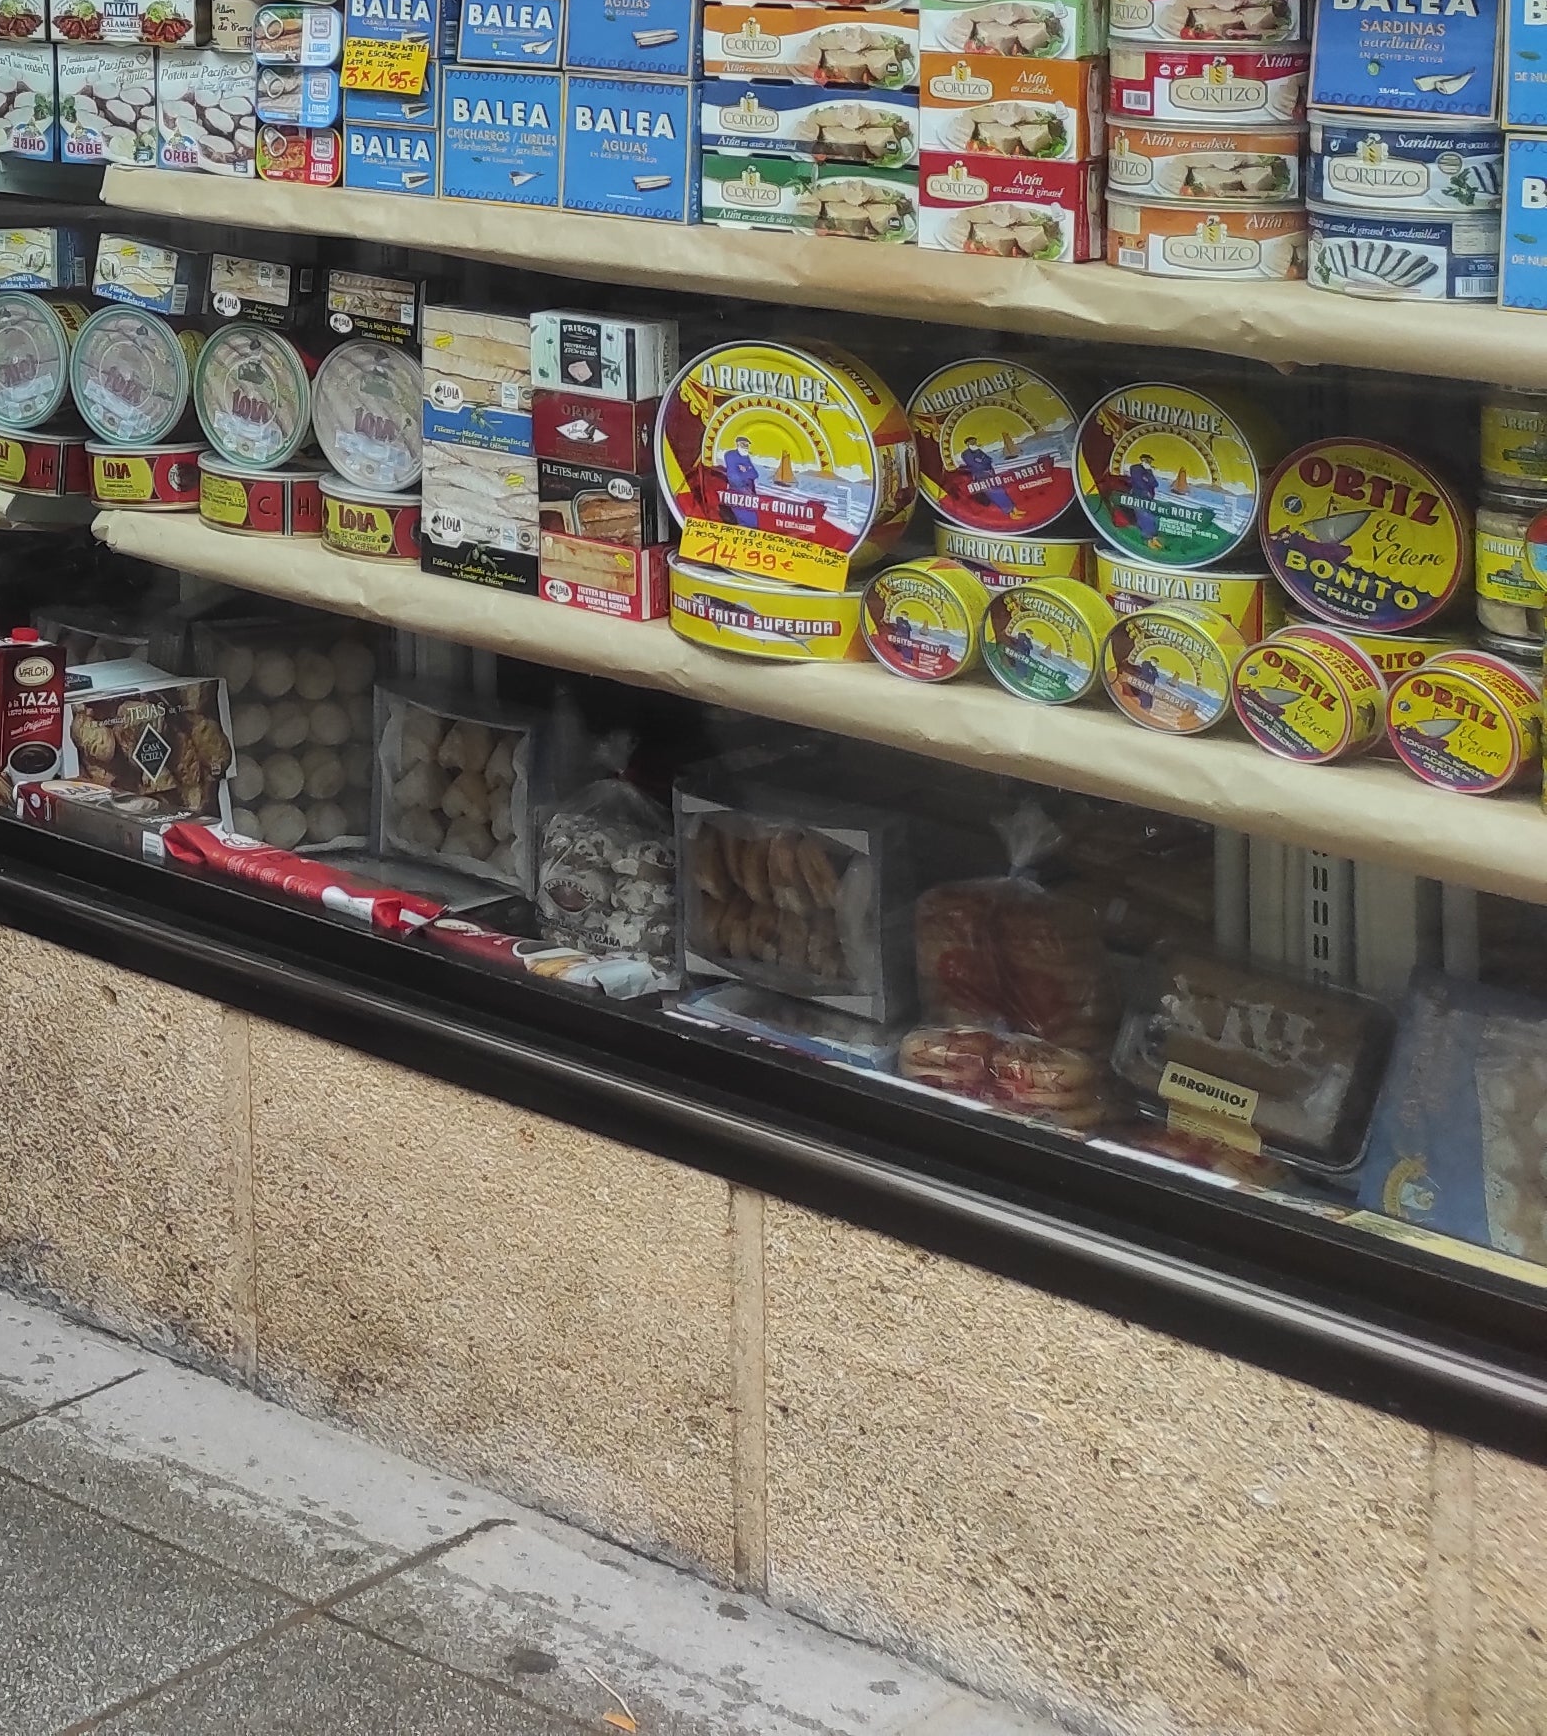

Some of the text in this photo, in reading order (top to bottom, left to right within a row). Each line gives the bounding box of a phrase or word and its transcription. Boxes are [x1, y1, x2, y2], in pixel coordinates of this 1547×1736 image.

[103, 2, 139, 18] MIAU
[467, 3, 554, 30] BALEA
[1360, 19, 1446, 37] SARDINAS
[725, 38, 777, 52] CORTIZO
[1256, 53, 1294, 69] Atún
[1016, 70, 1048, 86] Atún
[933, 81, 990, 96] CORTIZO
[1174, 84, 1260, 103] CORTIZO
[452, 97, 550, 129] BALEA
[723, 112, 775, 127] CORTIZO
[575, 105, 676, 141] BALEA
[67, 140, 102, 155] ORBE
[350, 133, 431, 162] BALEA
[602, 139, 649, 155] AGUJAS
[1140, 130, 1176, 148] Atún
[1395, 133, 1455, 151] Sardinas
[163, 148, 198, 164] ORBE
[1012, 171, 1045, 187] Atún
[1332, 167, 1422, 188] CORTIZO
[725, 187, 777, 202] CORTIZO
[930, 179, 985, 196] CORTIZO
[1244, 213, 1284, 232] Atún
[1169, 243, 1255, 263] CORTIZO
[443, 385, 460, 401] LOLA
[701, 364, 831, 404] ARROYABE
[920, 368, 1020, 413] ARROYABE
[1114, 396, 1223, 435] ARROYABE
[542, 463, 573, 480] FILETES
[967, 463, 1046, 495] BONITO NORTE
[618, 479, 633, 495] LOLA
[1298, 455, 1441, 526] ORTIZ
[717, 489, 815, 520] TROZOS BONITO
[1119, 494, 1204, 524] BONITO NORTE
[442, 517, 462, 534] LOLA
[1372, 518, 1399, 544] El
[945, 537, 1047, 567] ARROYABE
[1370, 543, 1446, 568] Velero
[1110, 566, 1222, 602] ARROYABE
[1283, 549, 1420, 611] BONITO
[1313, 581, 1378, 613] FRITO
[673, 593, 836, 636] BONITO FRITO SUPERIOR
[18, 665, 50, 679] VALOR
[1262, 650, 1338, 712] ORTIZ
[20, 691, 59, 707] TAZA
[1410, 679, 1499, 731] ORTIZ
[126, 704, 167, 722] TEJAS
[1170, 1071, 1249, 1109] BARQUILLOS
